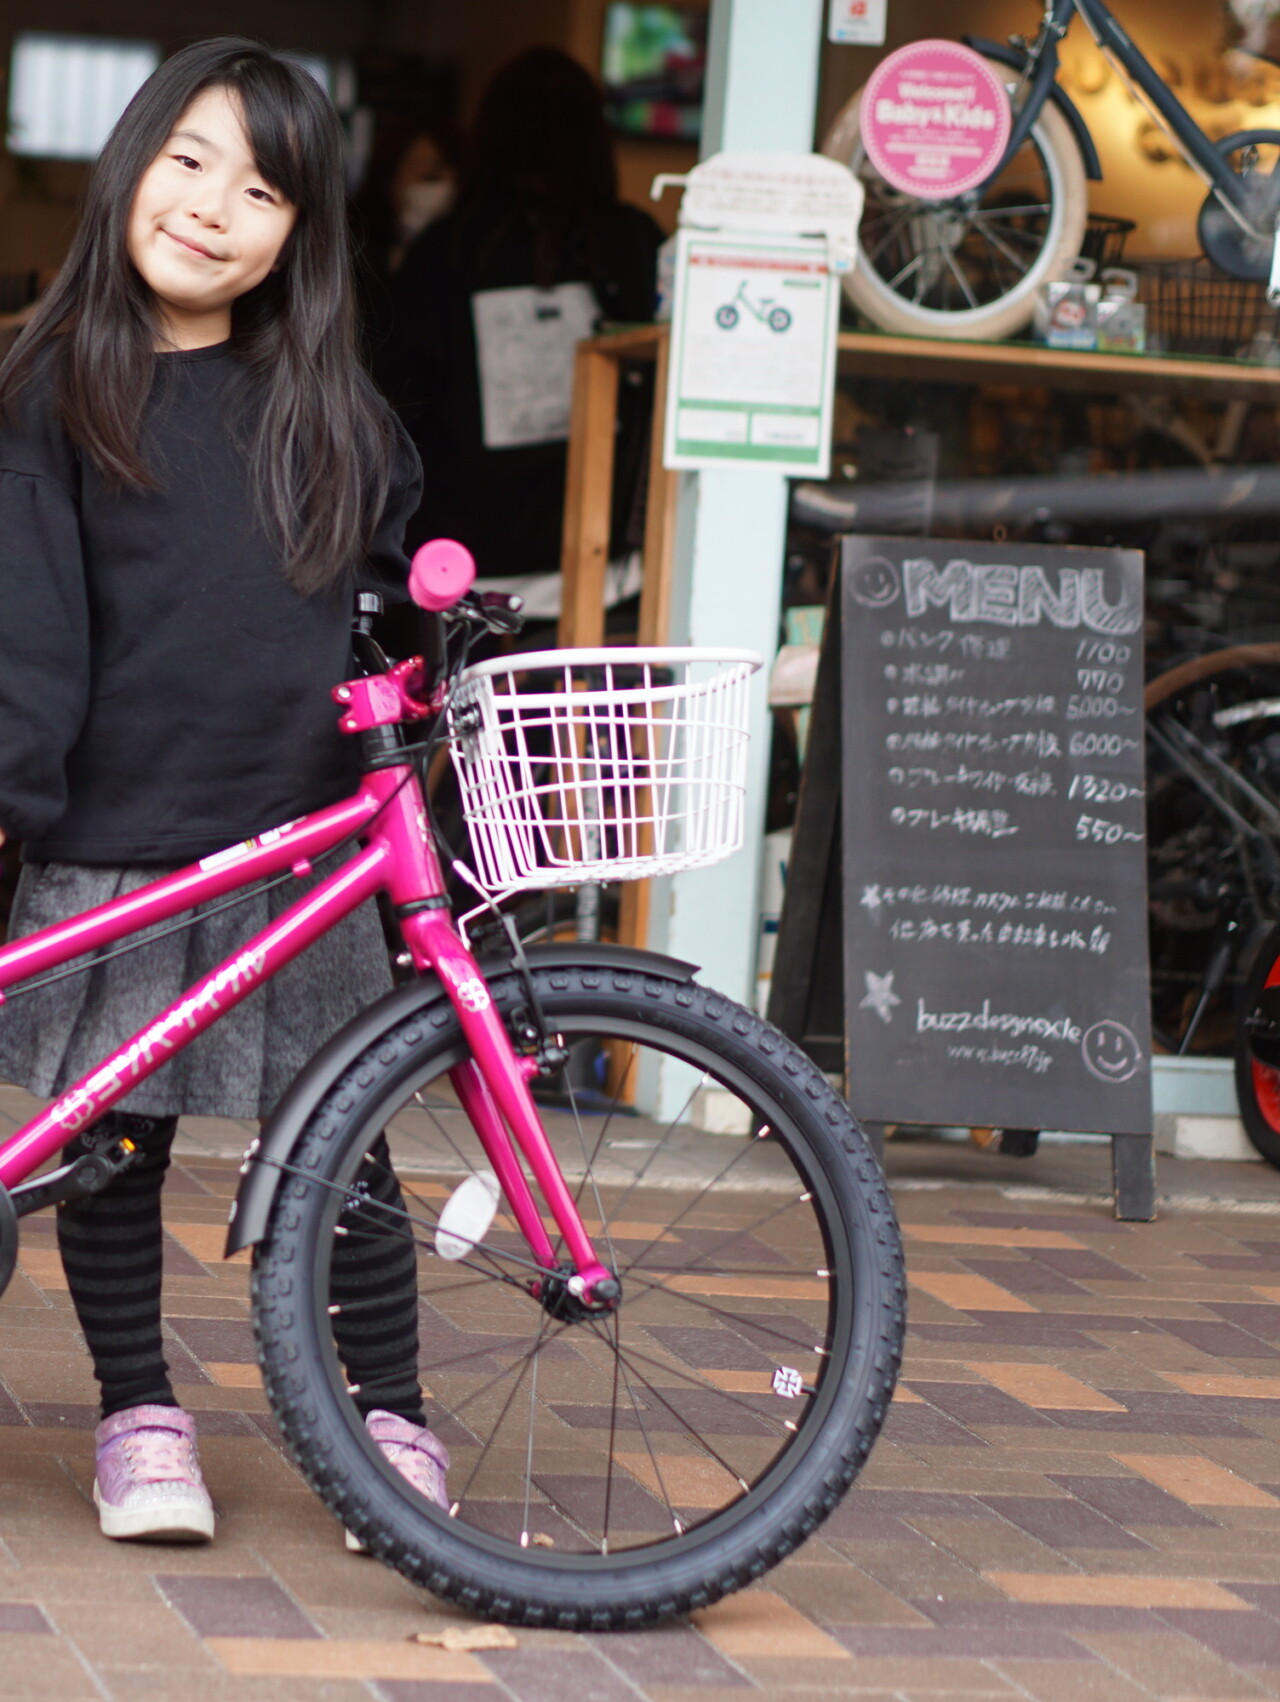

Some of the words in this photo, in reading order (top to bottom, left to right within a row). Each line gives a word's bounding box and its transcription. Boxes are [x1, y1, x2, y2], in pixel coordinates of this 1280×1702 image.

[903, 557, 1143, 636] MENU
[1076, 639, 1131, 664] 1100
[1077, 668, 1125, 694] 770
